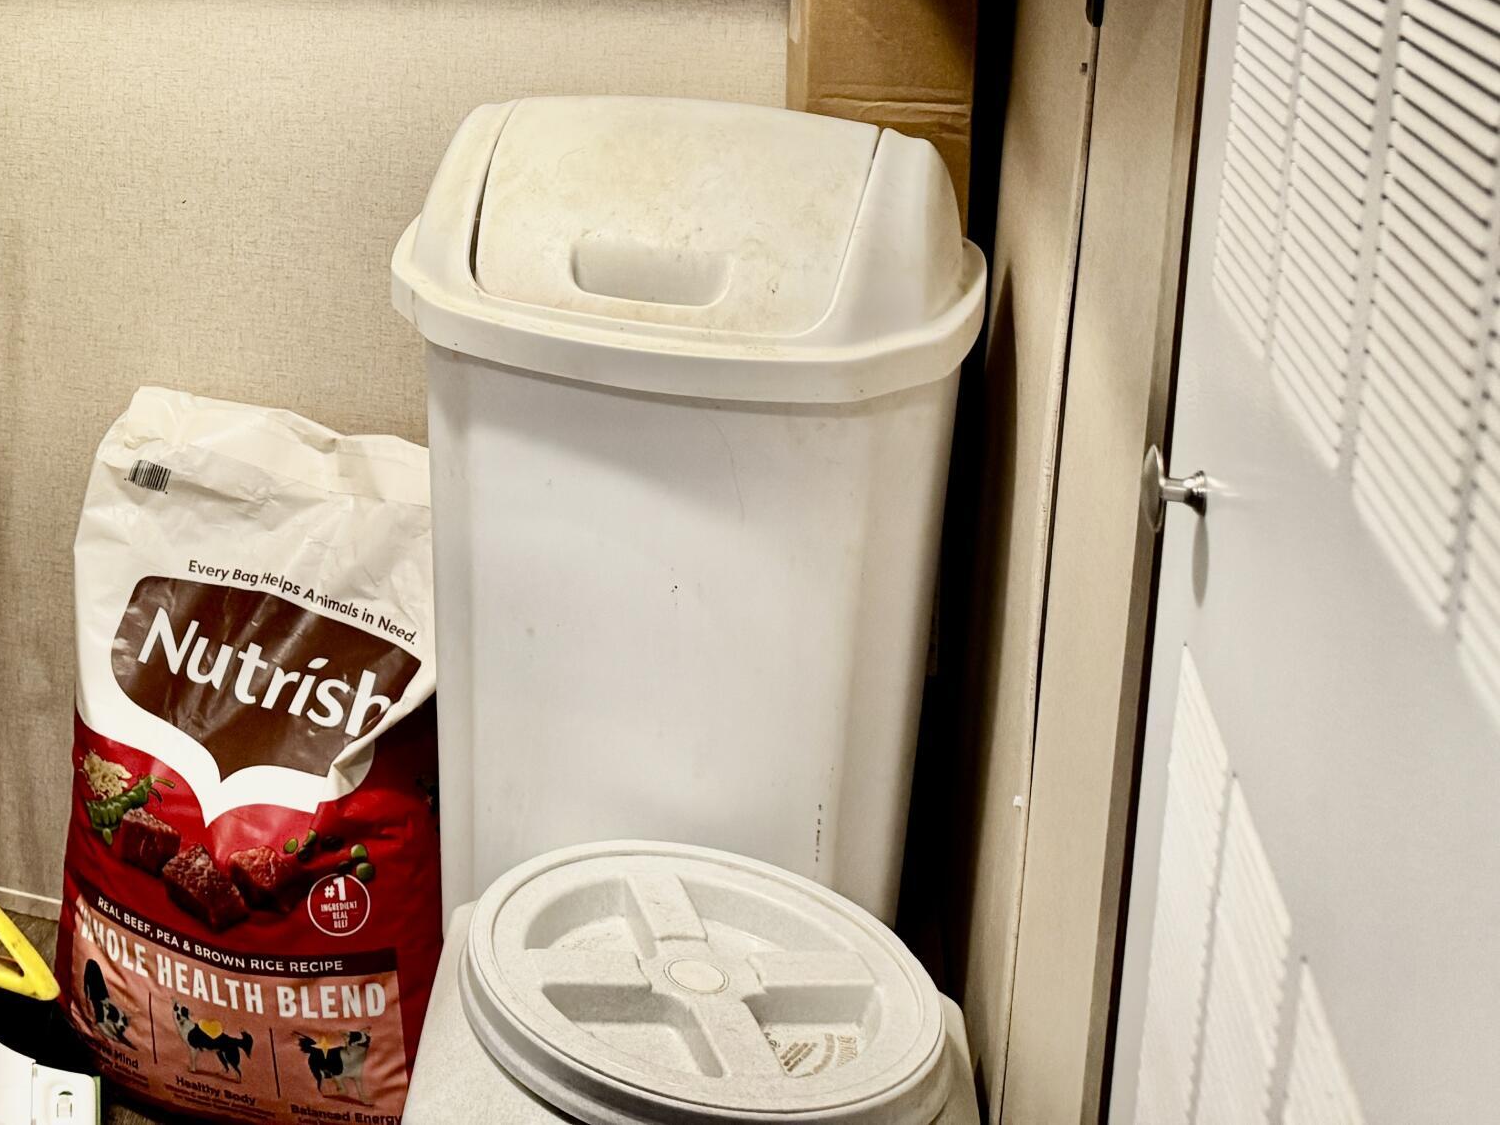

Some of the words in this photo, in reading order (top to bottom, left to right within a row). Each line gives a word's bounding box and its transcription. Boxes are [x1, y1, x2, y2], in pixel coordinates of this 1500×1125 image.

[188, 559, 230, 581] Every
[231, 568, 259, 587] Bag
[260, 572, 301, 596] Helps
[303, 588, 359, 618] Animals
[360, 607, 375, 625] in
[377, 615, 417, 645] Need.
[137, 606, 392, 737] Nutrish
[323, 876, 347, 901] #1
[320, 900, 358, 912] INGREDIENT
[332, 911, 348, 920] REAL
[97, 896, 122, 920] REAL
[123, 912, 153, 938] BEEF,
[156, 929, 180, 948] PEA
[182, 940, 191, 952] &
[194, 944, 245, 969] BROWN
[250, 958, 285, 972] RICE
[289, 960, 344, 973] RECIPE
[333, 919, 348, 928] BEEF
[156, 953, 264, 1015] HEALTH
[276, 982, 386, 1019] BLEND
[114, 1049, 139, 1069] Mind
[175, 1075, 221, 1097] Healthy
[223, 1089, 256, 1106] Body
[290, 1103, 350, 1122] Balanced
[354, 1112, 401, 1125] Energy
